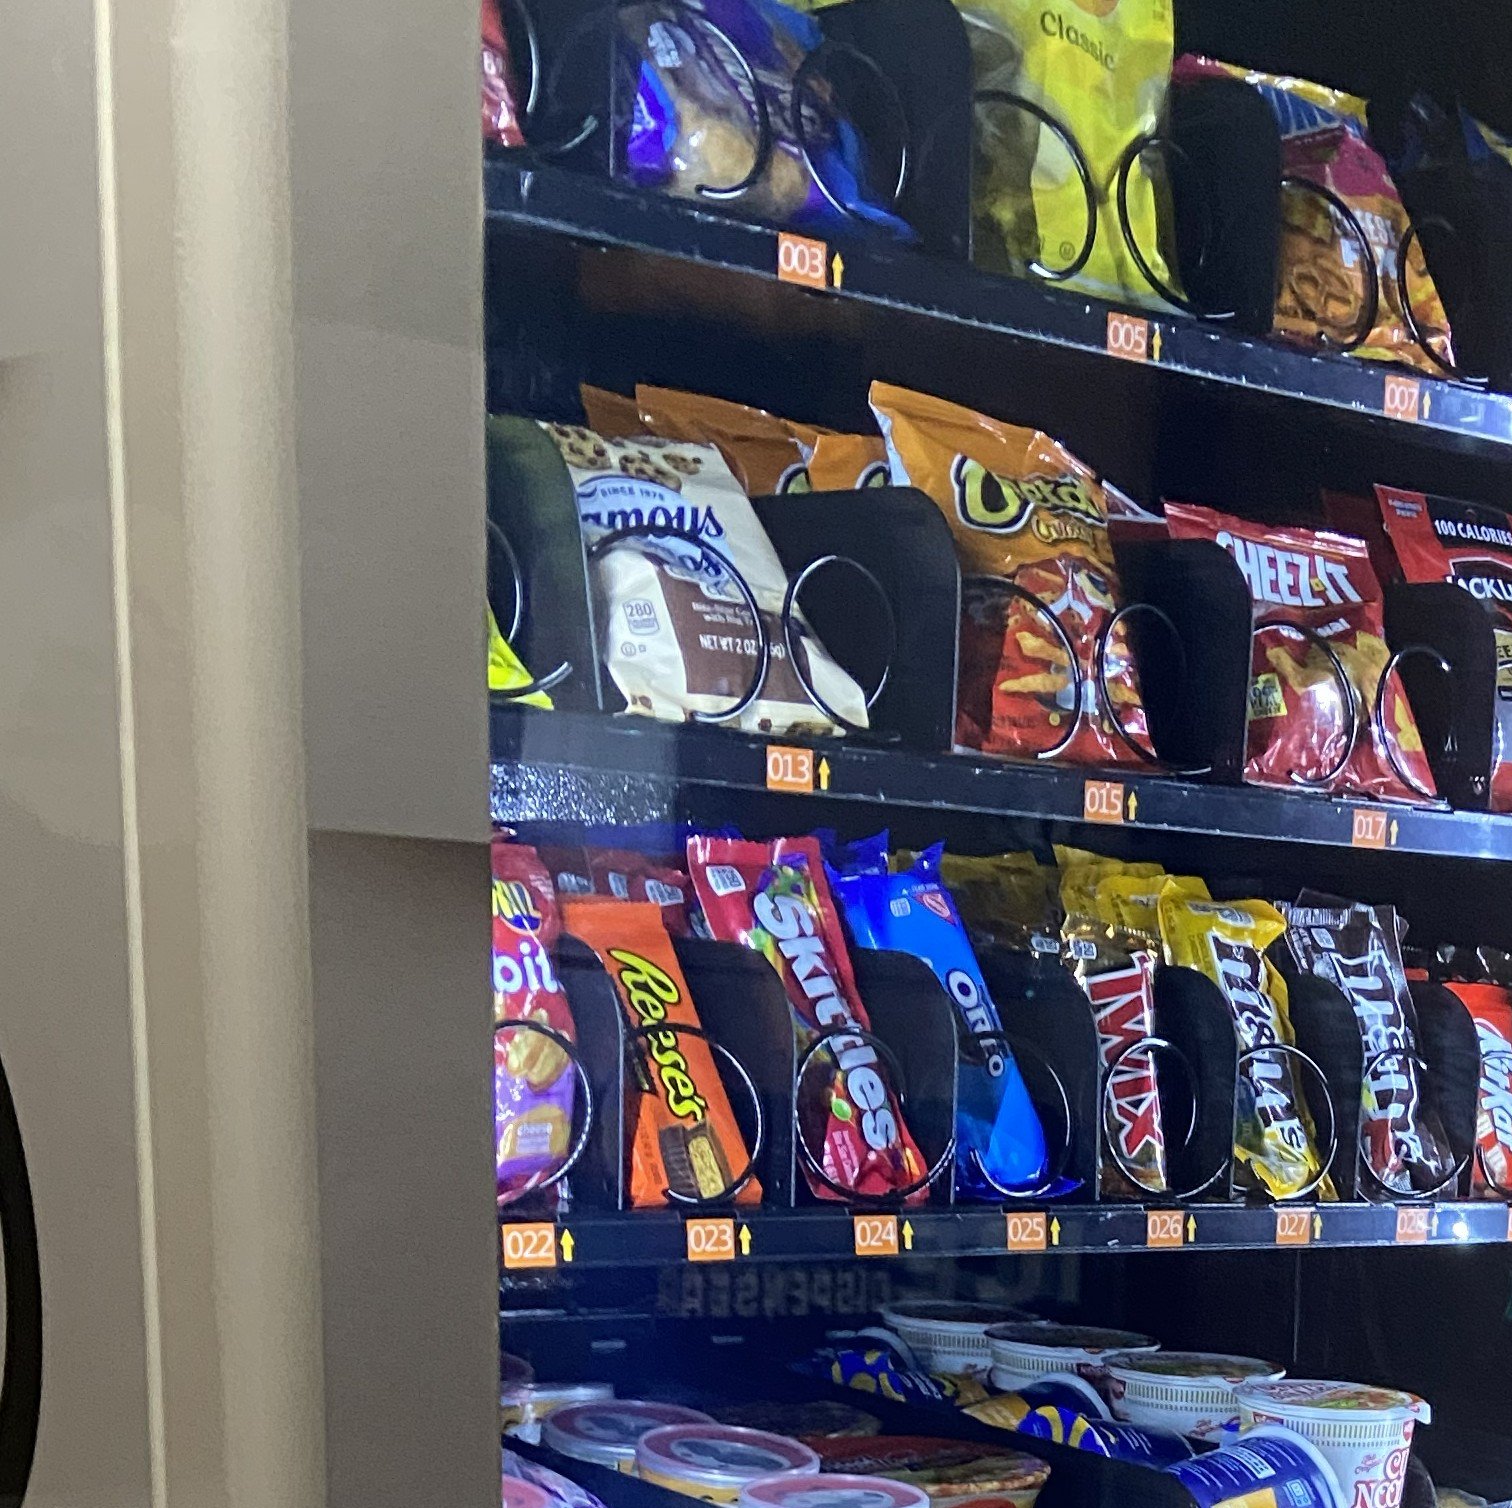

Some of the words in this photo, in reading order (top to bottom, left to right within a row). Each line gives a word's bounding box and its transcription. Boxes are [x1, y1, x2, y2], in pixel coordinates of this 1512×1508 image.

[1040, 10, 1115, 71] Classic
[779, 243, 824, 275] 003
[1108, 320, 1146, 352] 005
[1385, 383, 1418, 413] 007
[1434, 519, 1456, 538] 100
[626, 601, 652, 617] 280
[769, 756, 810, 780] 013
[1086, 788, 1122, 815] 015
[1355, 816, 1385, 842] 017
[608, 947, 708, 1124] Reese's
[946, 968, 1005, 1078] OREO
[1085, 950, 1164, 1158] TWIX
[856, 1222, 896, 1248] 024
[1009, 1218, 1045, 1242] 025
[1148, 1215, 1182, 1237] 026
[1277, 1214, 1309, 1236] 027
[505, 1233, 554, 1259] 022
[689, 1227, 733, 1253] 023
